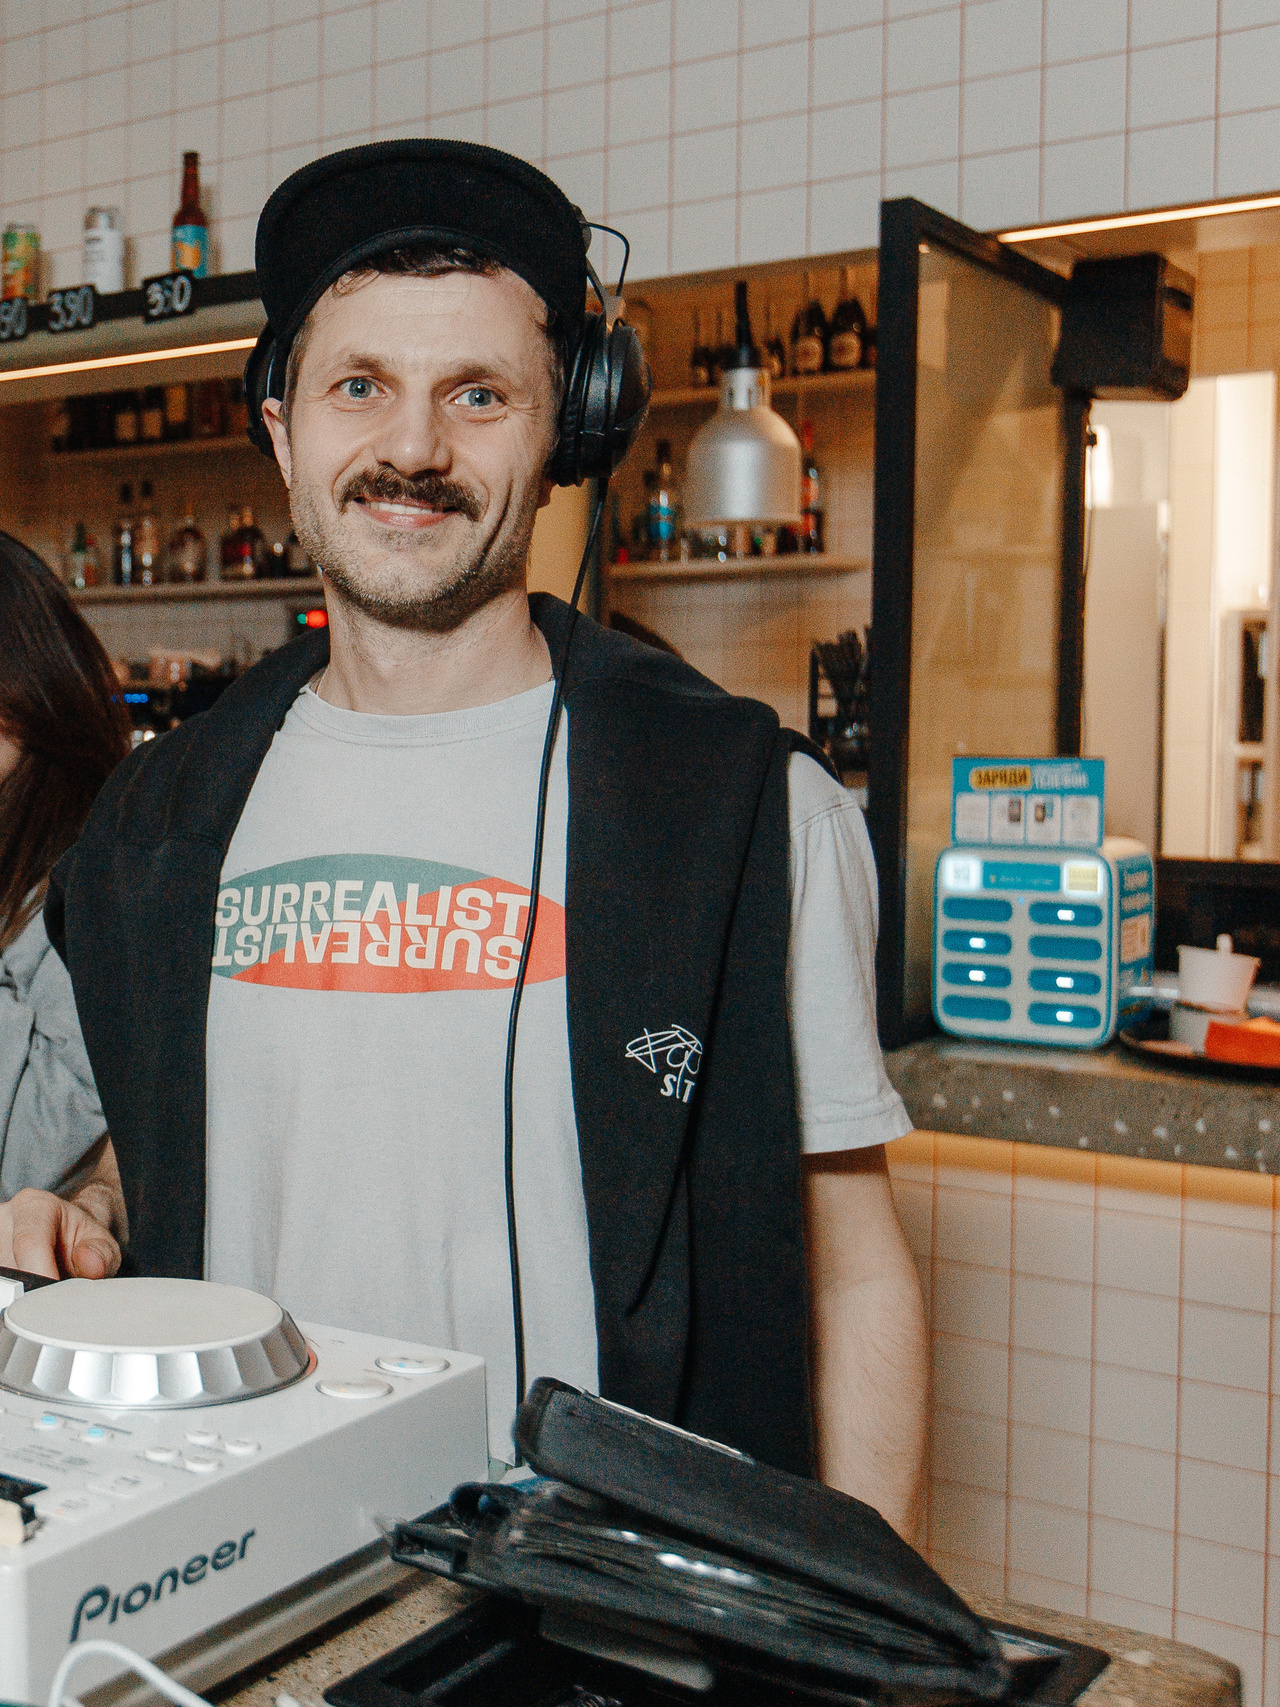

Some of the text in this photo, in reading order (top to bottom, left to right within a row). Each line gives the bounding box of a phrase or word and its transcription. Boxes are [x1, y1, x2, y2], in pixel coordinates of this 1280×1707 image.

[216, 879, 531, 937] SURREALIST
[211, 921, 524, 980] SURREALIST
[69, 1528, 256, 1645] Pioneer
